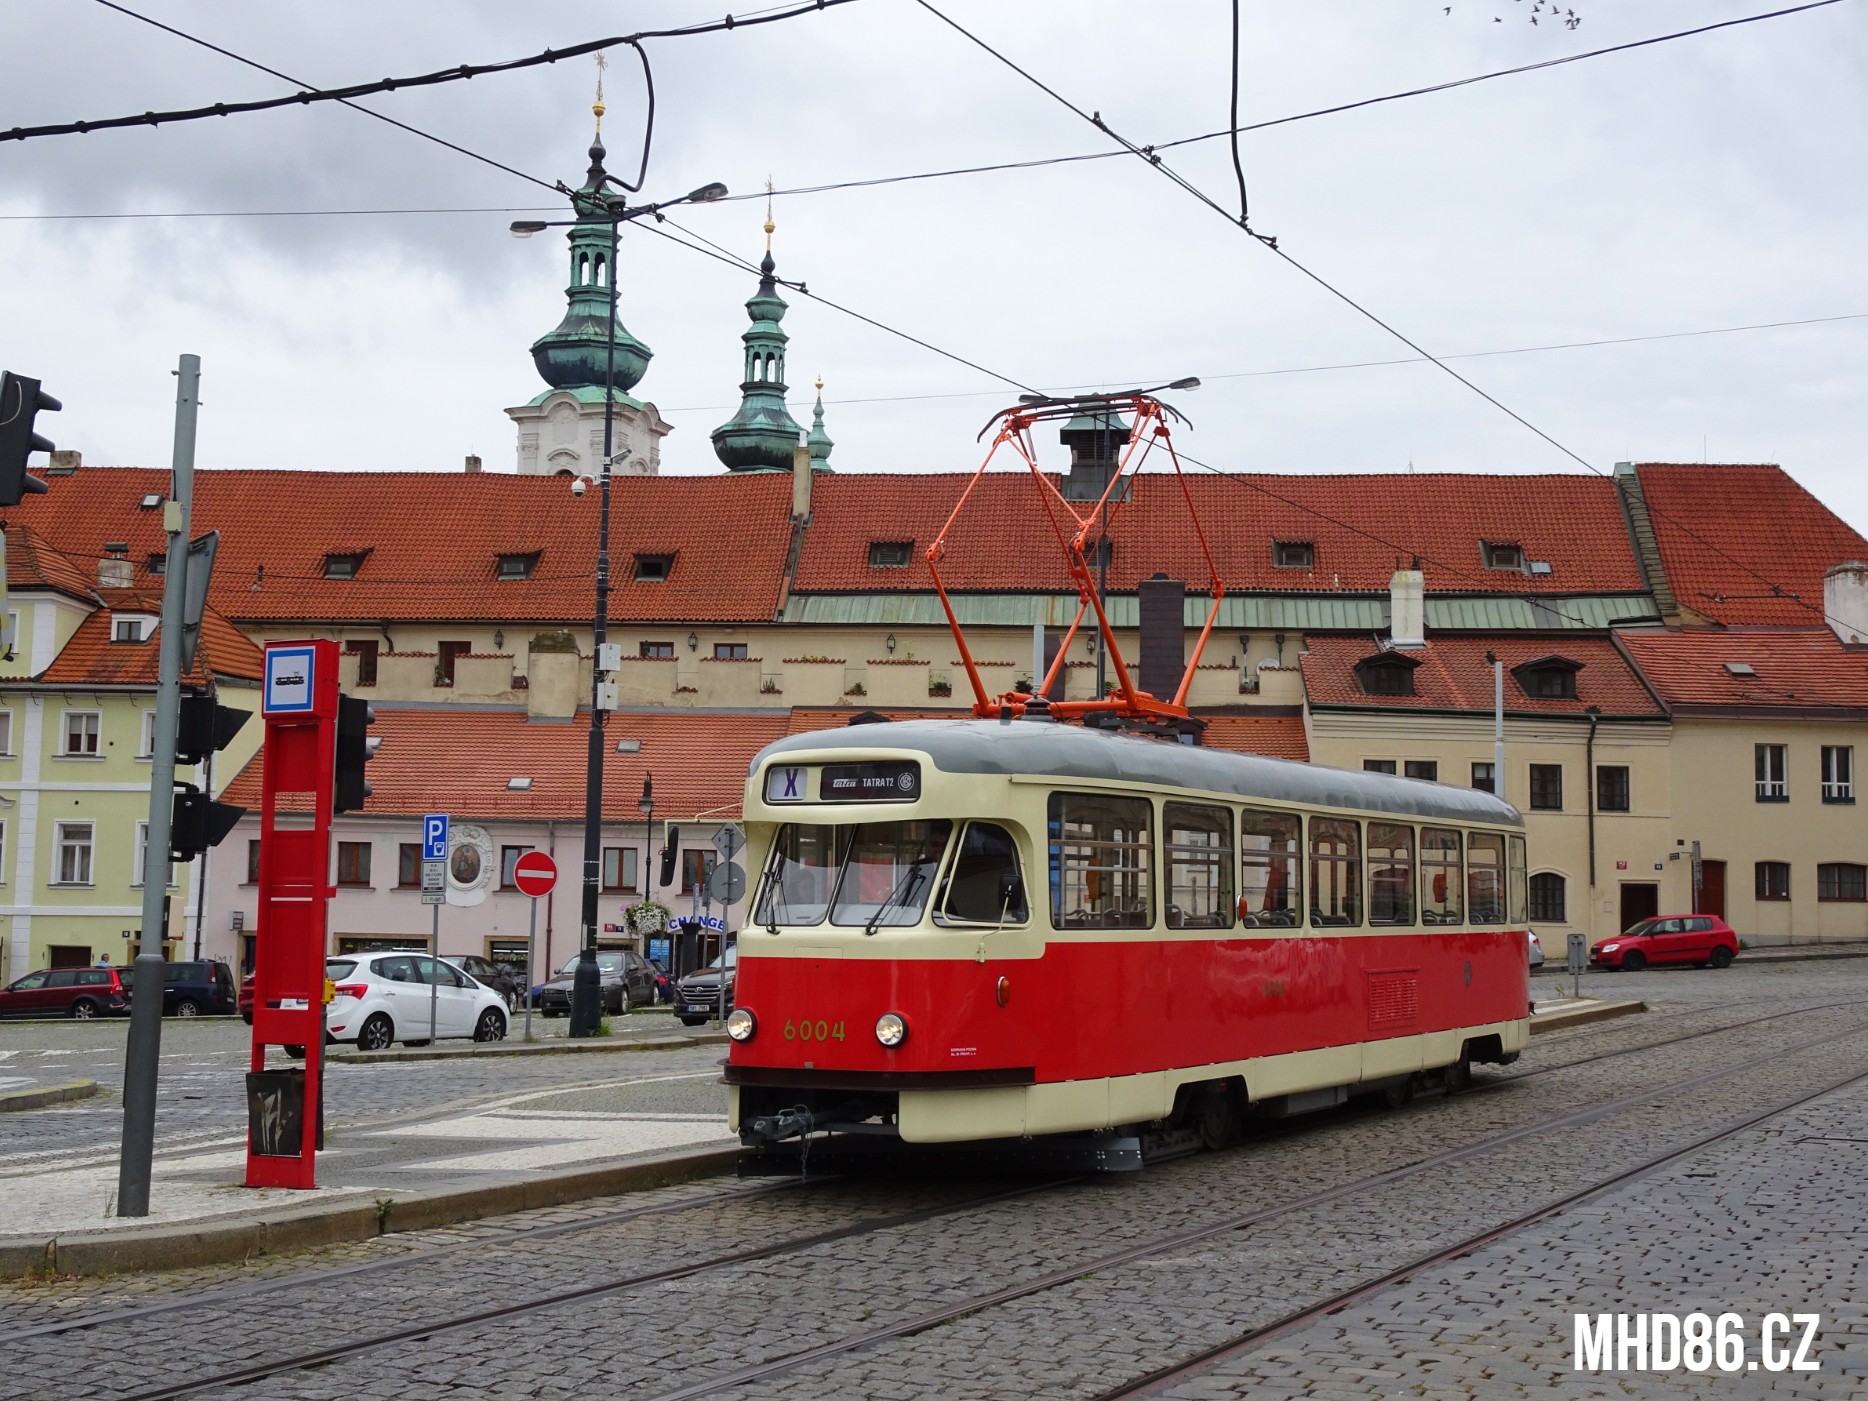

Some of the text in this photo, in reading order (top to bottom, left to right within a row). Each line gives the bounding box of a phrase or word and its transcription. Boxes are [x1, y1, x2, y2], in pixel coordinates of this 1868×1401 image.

[784, 768, 799, 797] X
[862, 778, 884, 787] TATRA
[428, 819, 443, 846] P
[783, 1018, 846, 1042] 6004
